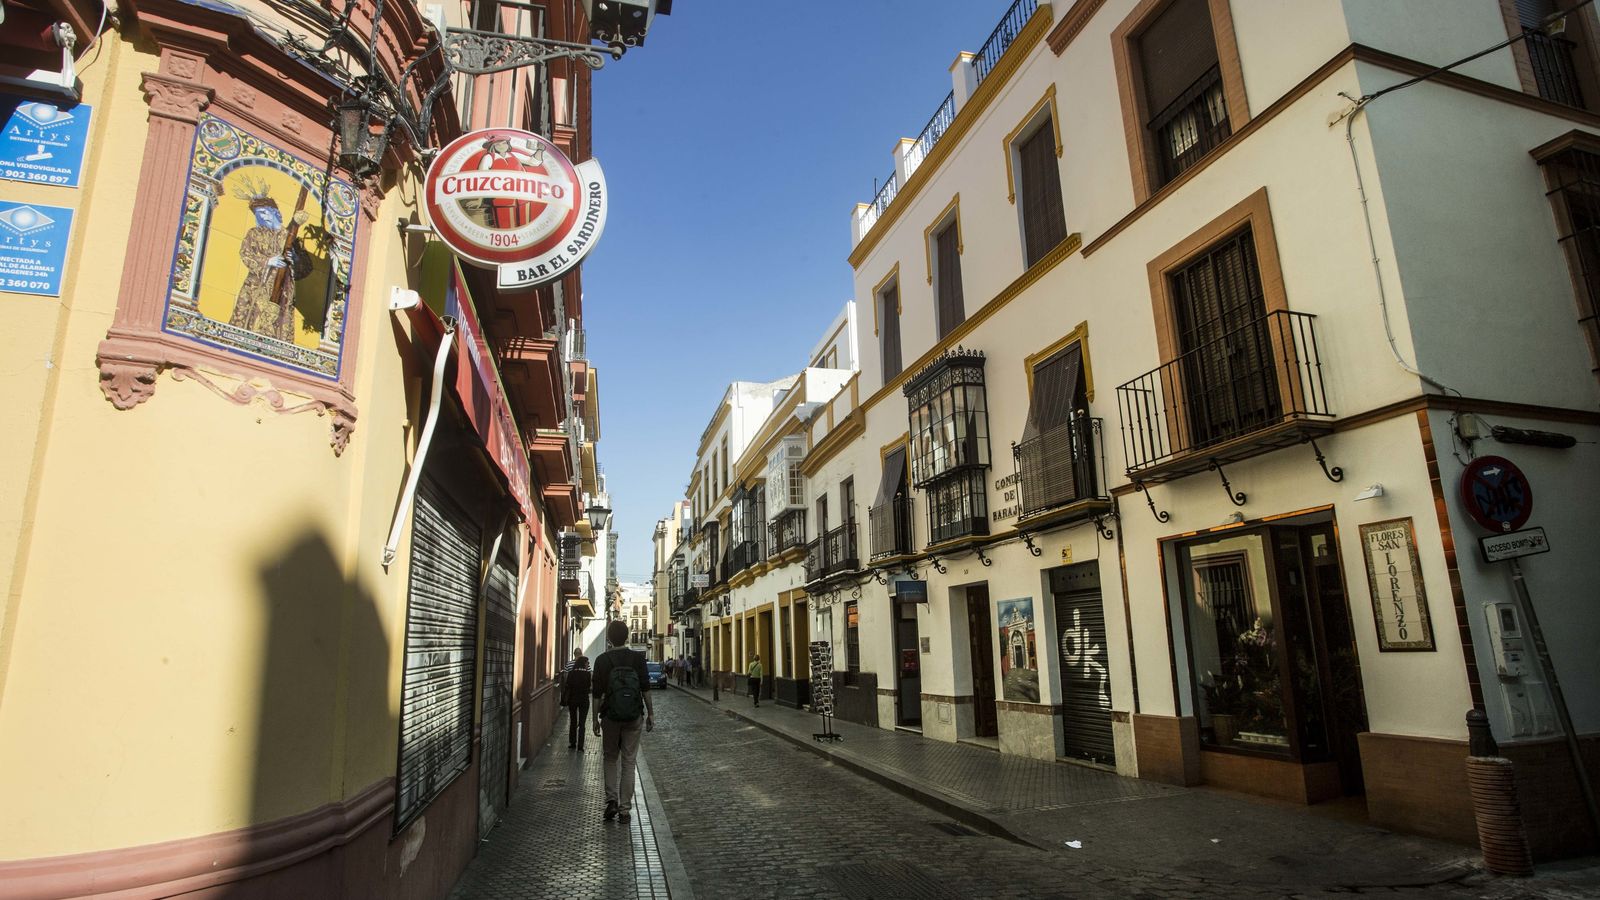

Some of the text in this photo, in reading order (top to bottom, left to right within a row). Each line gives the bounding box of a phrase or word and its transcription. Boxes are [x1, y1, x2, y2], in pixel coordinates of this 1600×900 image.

[16, 162, 72, 175] VIDEOVIGILADA
[5, 169, 70, 184] 902 360 897
[442, 175, 565, 199] Cruzcampo
[516, 263, 550, 281] BAR
[548, 254, 569, 271] EL
[566, 181, 602, 256] SARDINERO
[490, 232, 519, 248] 1904
[7, 279, 28, 288] 360
[29, 281, 51, 290] 070
[1004, 489, 1016, 502] DE
[1370, 529, 1404, 543] FLORES
[1378, 539, 1401, 552] SAN
[1487, 541, 1512, 554] ACCESO
[1385, 552, 1409, 641] LORENZO
